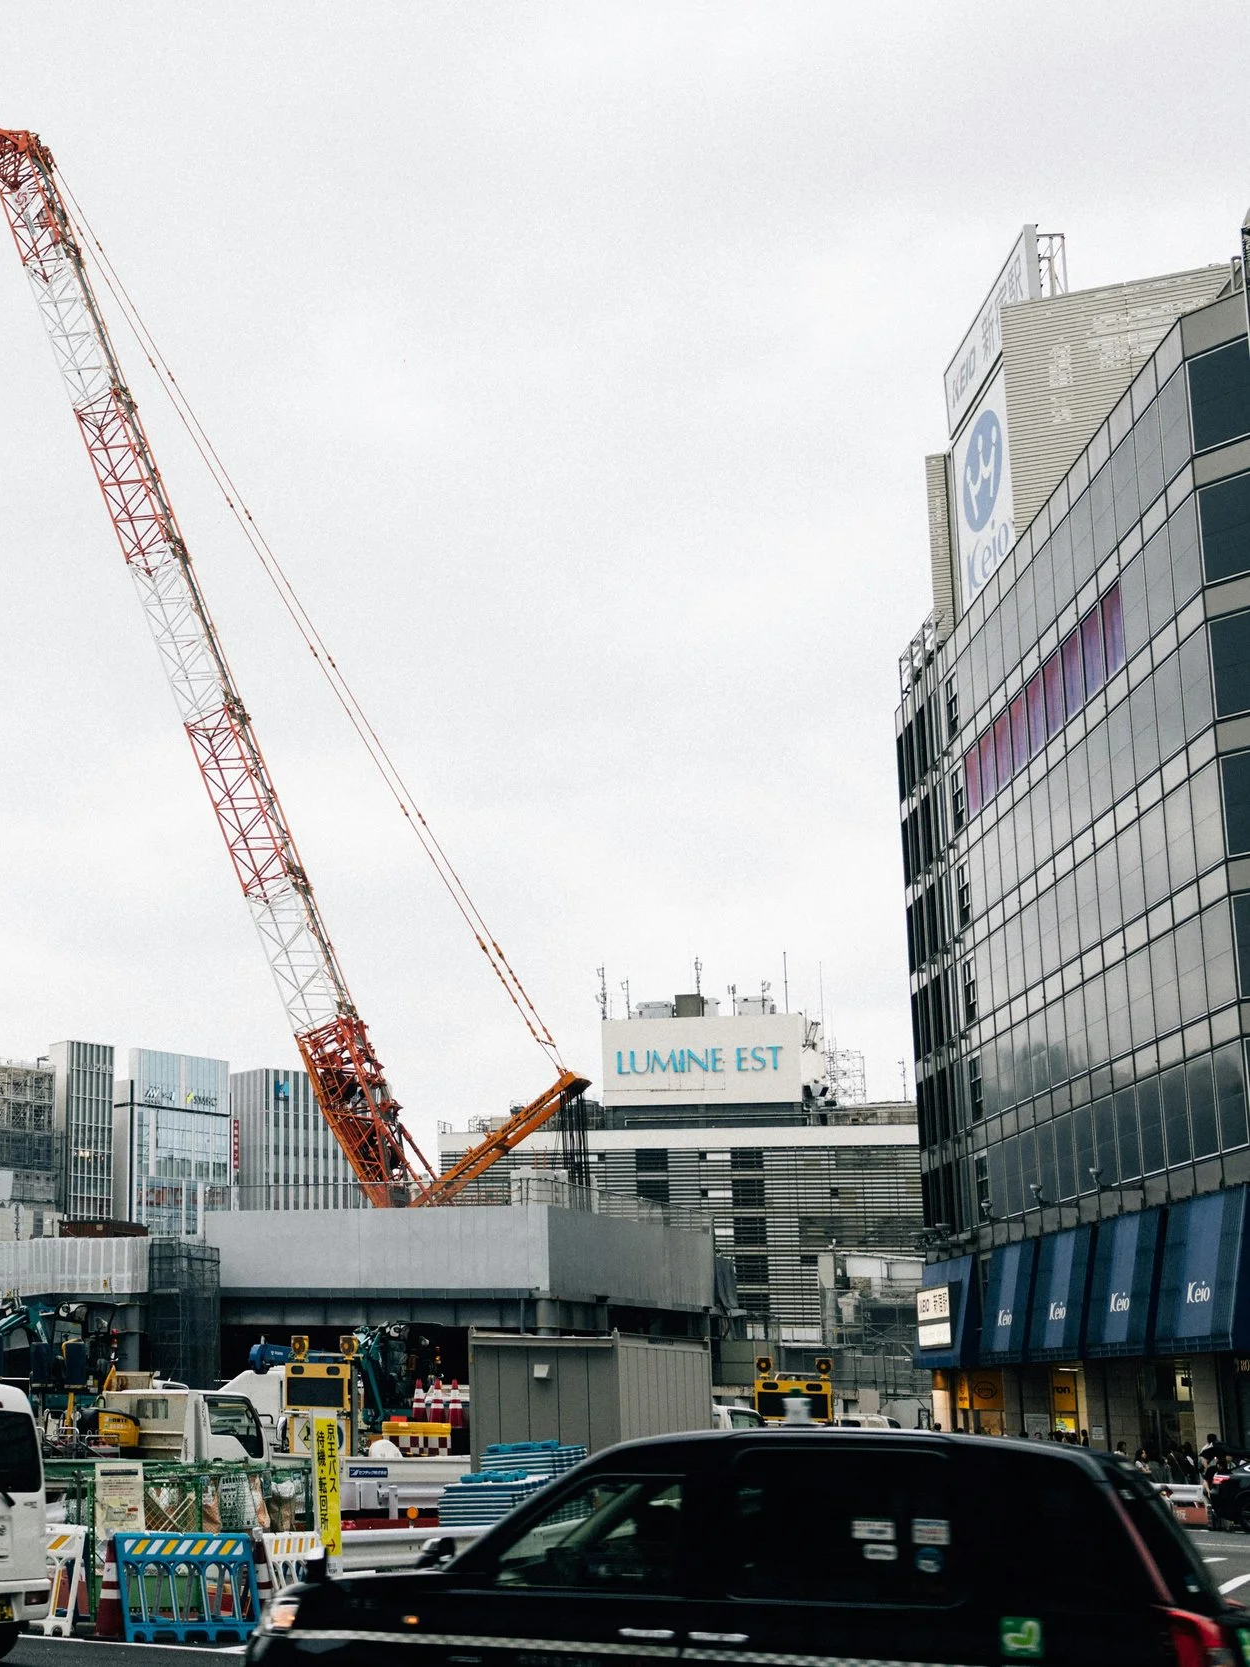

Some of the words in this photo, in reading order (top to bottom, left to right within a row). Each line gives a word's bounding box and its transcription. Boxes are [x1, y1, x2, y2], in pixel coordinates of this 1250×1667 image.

[967, 519, 1009, 600] Keio
[617, 1048, 725, 1075] LUMINE
[736, 1046, 783, 1072] EST
[1110, 1292, 1130, 1313] Keio
[1186, 1280, 1211, 1304] Keio
[997, 1309, 1012, 1327] Keio
[1050, 1301, 1067, 1321] Keio
[326, 1424, 338, 1493] 京王バス
